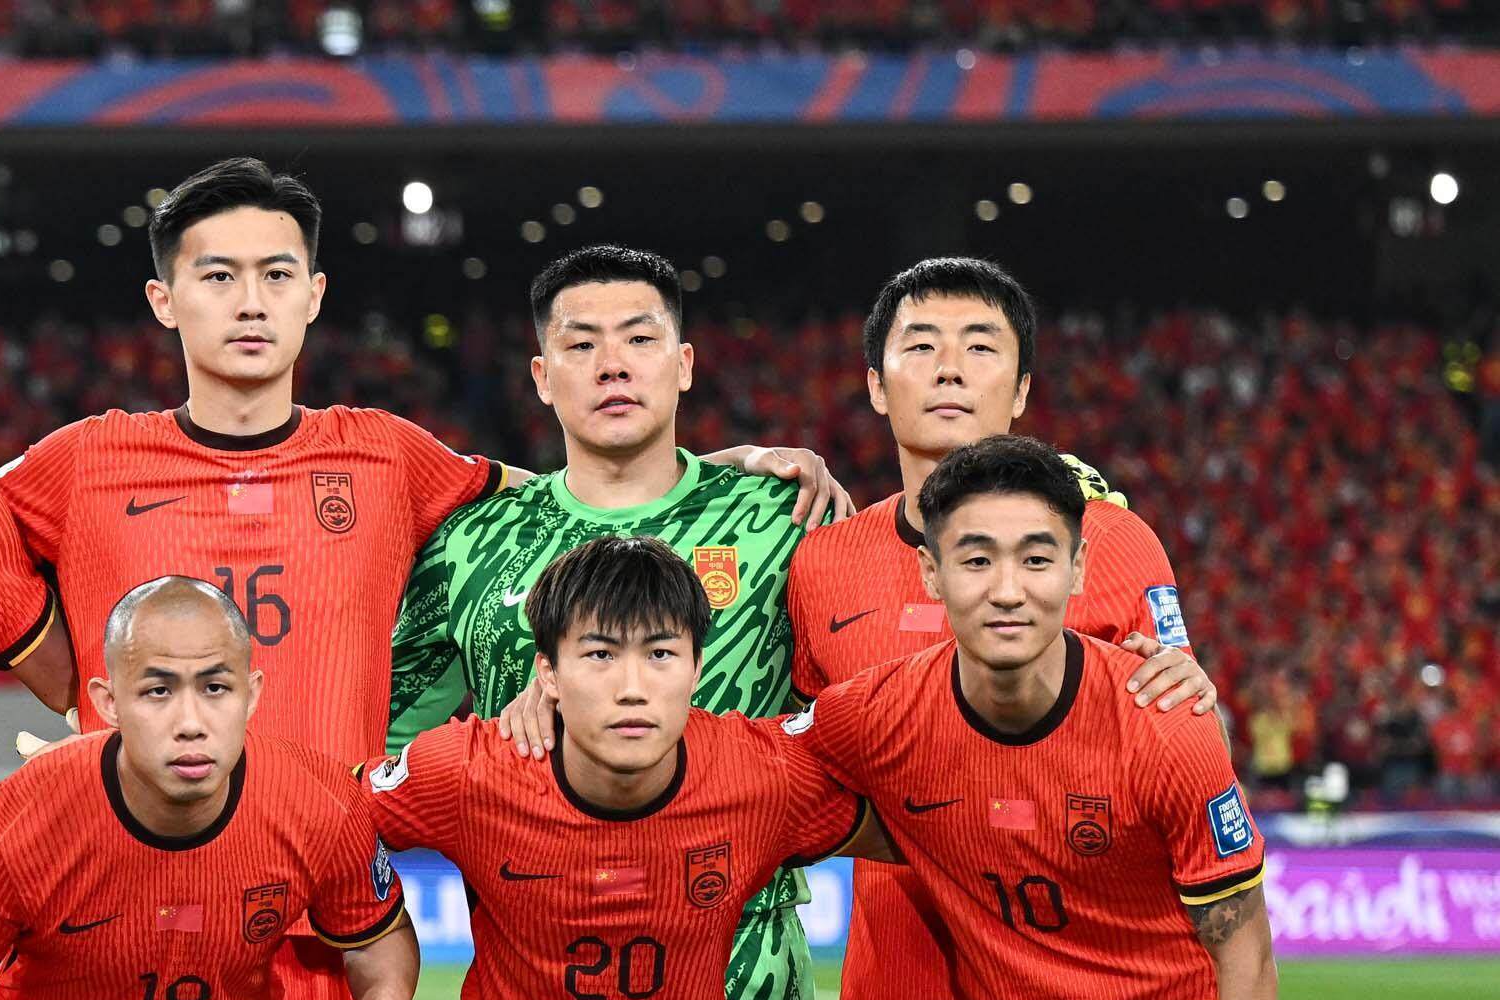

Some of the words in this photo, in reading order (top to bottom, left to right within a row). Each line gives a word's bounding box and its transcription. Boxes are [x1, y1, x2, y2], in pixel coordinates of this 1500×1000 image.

[315, 475, 348, 487] CFA
[699, 550, 734, 562] CFA
[1069, 799, 1106, 812] CFA
[691, 850, 726, 864] CFA
[248, 888, 284, 902] CFA
[981, 872, 1069, 933] 10
